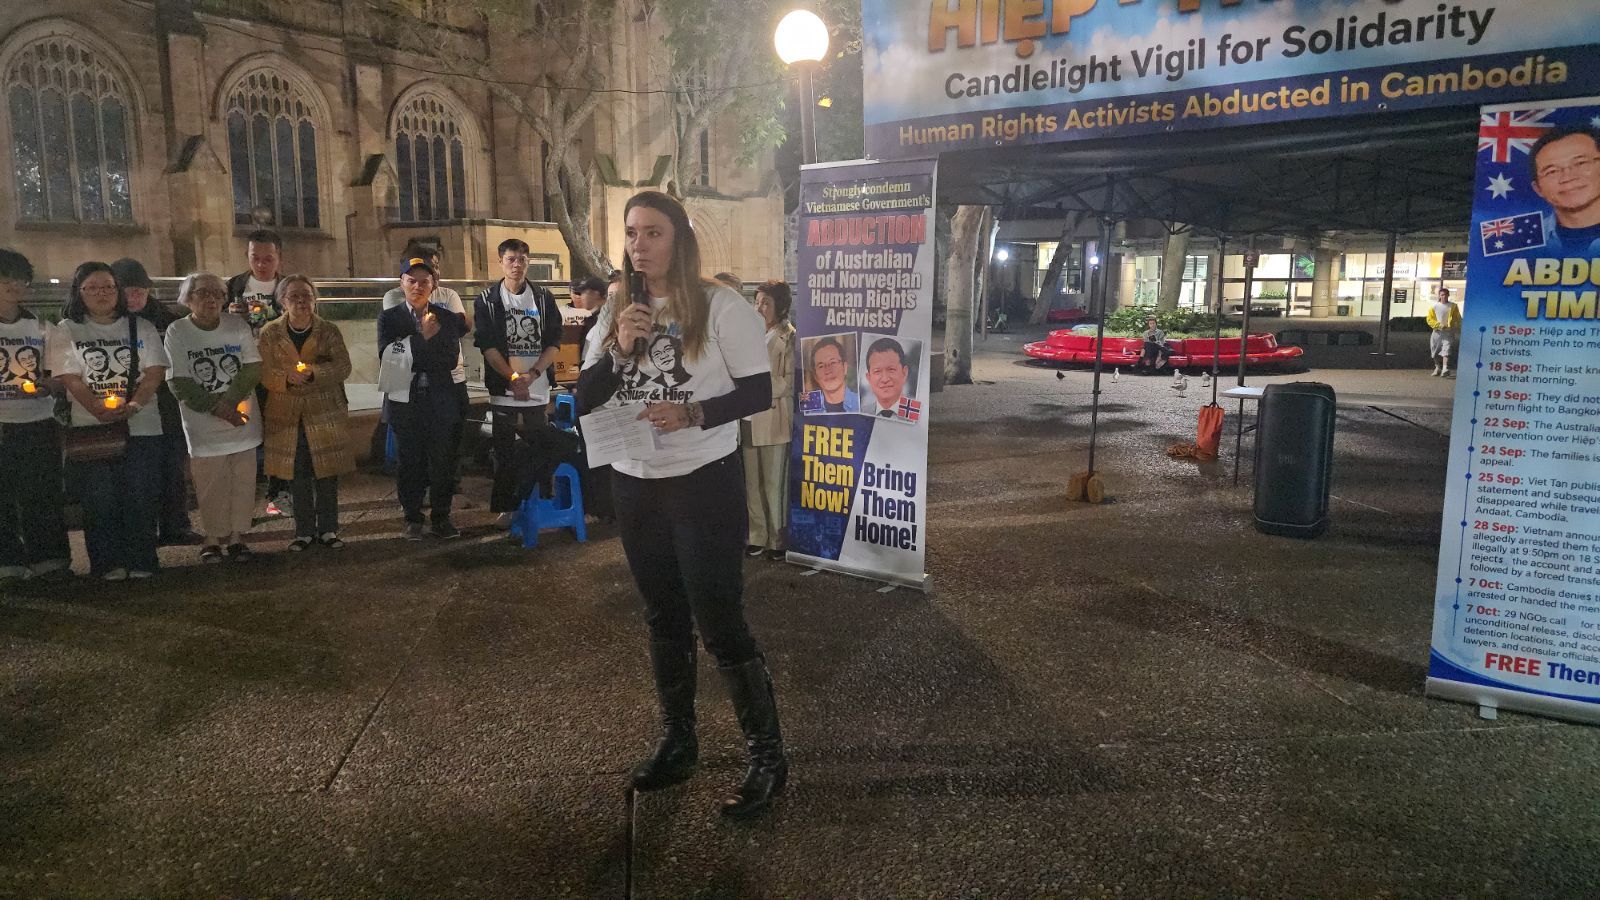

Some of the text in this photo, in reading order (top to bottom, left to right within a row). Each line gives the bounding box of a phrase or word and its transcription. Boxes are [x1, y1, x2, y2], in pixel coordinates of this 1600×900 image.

[945, 3, 1496, 100] Candlelight Vigil for Solidarity
[898, 55, 1568, 147] Human Rights Activists Abducted in Cambodia
[823, 181, 911, 199] Strongly condemn
[806, 194, 931, 213] Vietnamese Government's
[807, 214, 926, 246] ABDUCTION
[816, 249, 913, 270] of Australian
[808, 270, 921, 291] and Norwegian
[811, 289, 917, 310] Human Rights
[1522, 291, 1600, 319] TIM
[825, 308, 897, 329] Activists!
[1492, 326, 1505, 334] 15
[1509, 326, 1535, 336] Sep:
[1566, 328, 1585, 336] and
[97, 338, 121, 347] Them
[1504, 338, 1539, 347] Phnom
[1543, 339, 1570, 348] Penh
[1573, 340, 1583, 348] to
[187, 350, 204, 360] Free
[204, 347, 225, 355] Them
[1490, 348, 1532, 357] activists.
[1489, 362, 1502, 371] 18
[1505, 363, 1532, 373] Sep:
[1536, 364, 1560, 372] Their
[1564, 365, 1582, 374] last
[1510, 374, 1529, 383] that
[1532, 376, 1576, 386] morning.
[648, 388, 660, 400] &
[662, 387, 694, 404] Hiep
[1487, 390, 1600, 404] 19 Sep: They did not
[1485, 403, 1514, 411] return
[1517, 404, 1543, 414] flight
[1484, 417, 1498, 426] 22
[1503, 418, 1529, 430] Sep:
[1534, 420, 1552, 429] The
[803, 424, 854, 459] FREE
[1483, 429, 1568, 443] intervention over
[1479, 457, 1514, 467] appeal.
[1481, 445, 1496, 454] 24
[1499, 446, 1526, 458] Sep:
[1530, 449, 1549, 458] The
[1552, 451, 1590, 461] families
[802, 454, 854, 488] Them
[863, 461, 917, 498] Bring
[1479, 473, 1493, 482] 25
[1497, 474, 1523, 486] Sep:
[1528, 477, 1547, 486] Viet
[1551, 479, 1567, 488] Tan
[801, 481, 850, 514] Now!
[1477, 485, 1528, 496] statement
[1531, 490, 1550, 498] and
[861, 488, 916, 524] Them
[1476, 496, 1567, 511] disappeared while
[1516, 510, 1568, 522] Cambodia.
[855, 515, 918, 552] Home!
[1474, 520, 1563, 537] 28 Sep: Vietnam
[1473, 532, 1516, 544] allegedly
[1518, 537, 1560, 548] arrested
[1562, 541, 1588, 552] them
[1472, 542, 1507, 554] illegally
[1510, 547, 1519, 555] at
[1522, 548, 1559, 560] 9:50pm
[1580, 554, 1591, 562] 18
[1470, 563, 1508, 574] followed
[1511, 567, 1523, 577] by
[1534, 570, 1564, 581] forced
[1471, 554, 1503, 564] rejects
[1512, 557, 1528, 566] the
[1530, 559, 1570, 571] account
[1573, 565, 1592, 574] and
[1469, 578, 1591, 601] 7 Oct: Cambodia denies
[1467, 590, 1505, 601] arrested
[1521, 595, 1557, 608] handed
[1560, 602, 1575, 610] the
[1467, 604, 1594, 629] 7 Oct: 29 NGOs call for
[1465, 616, 1529, 631] unconditional
[1532, 625, 1568, 638] release,
[1464, 626, 1507, 639] detention
[1511, 632, 1555, 647] locations,
[1559, 640, 1577, 649] and
[1501, 642, 1518, 651] and
[1521, 645, 1560, 657] consular
[1485, 652, 1600, 685] FREE Them
